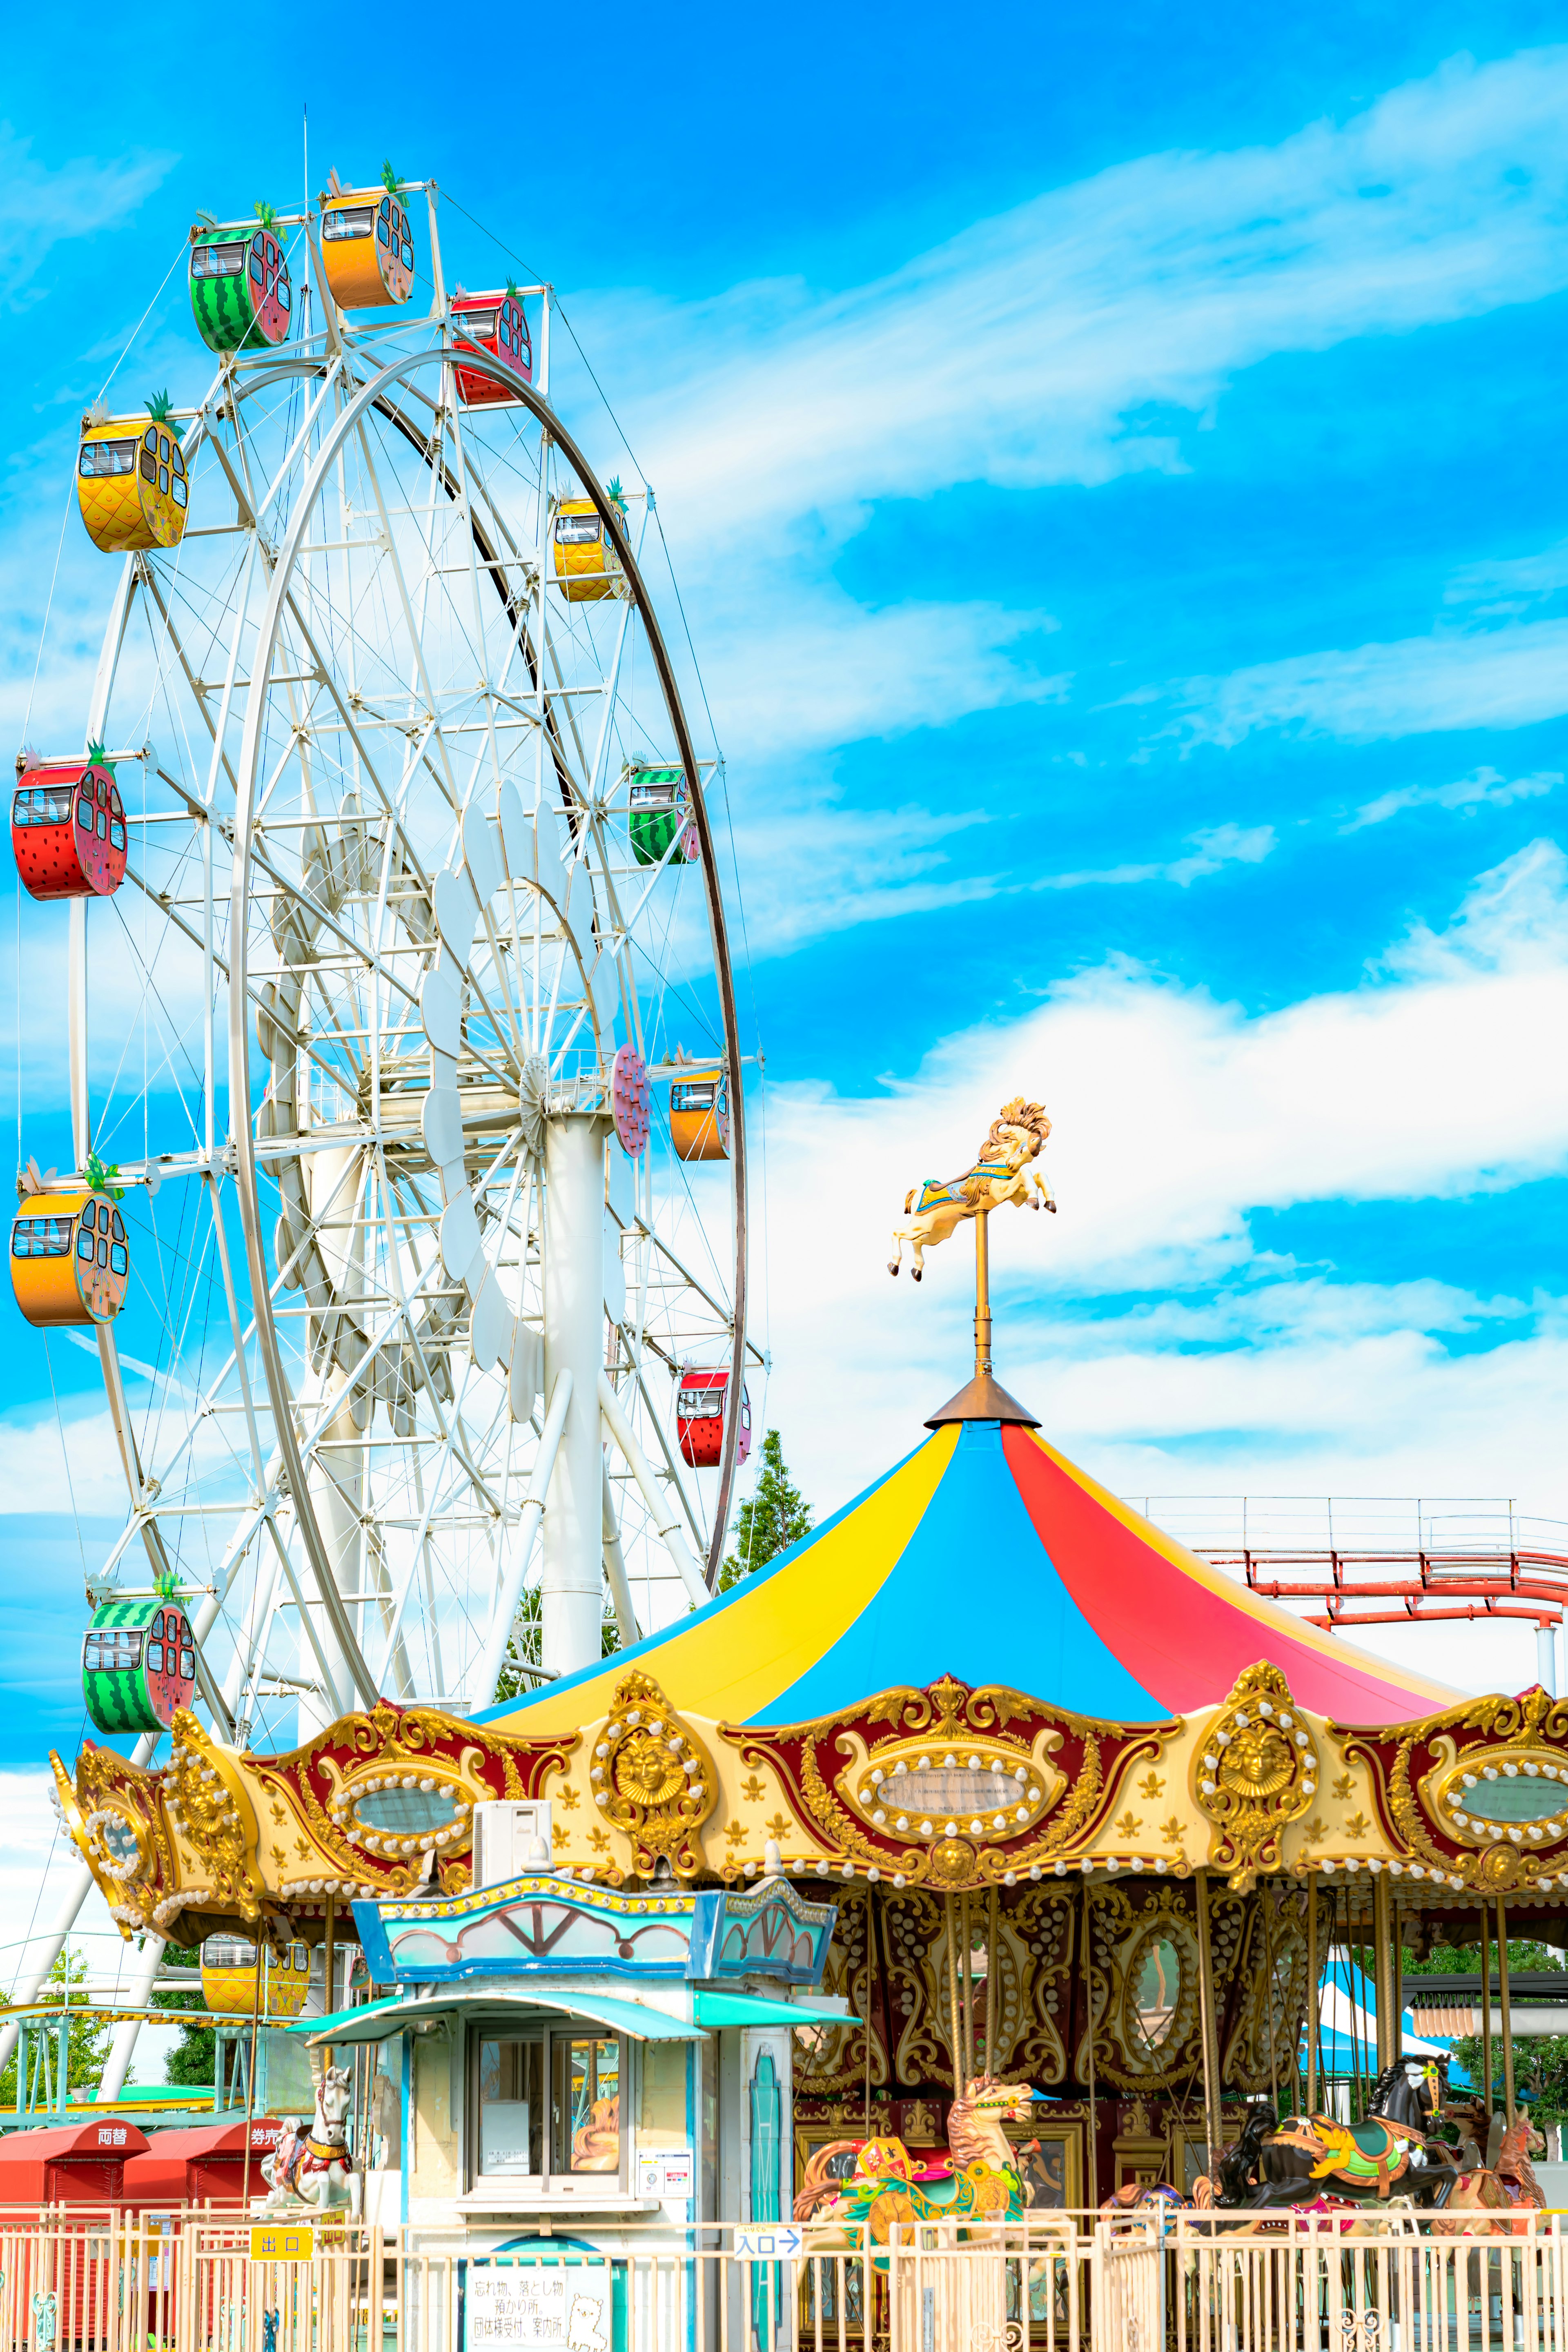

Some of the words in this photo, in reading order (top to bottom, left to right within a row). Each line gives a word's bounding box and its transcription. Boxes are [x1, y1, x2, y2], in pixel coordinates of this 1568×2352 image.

[98, 2128, 127, 2145] 両替
[251, 2128, 278, 2145] 券売
[262, 2236, 298, 2252] 出口
[736, 2236, 775, 2254] 入口
[475, 2280, 563, 2296] 忘れ物、落とし物
[495, 2299, 543, 2315] 預かり所。
